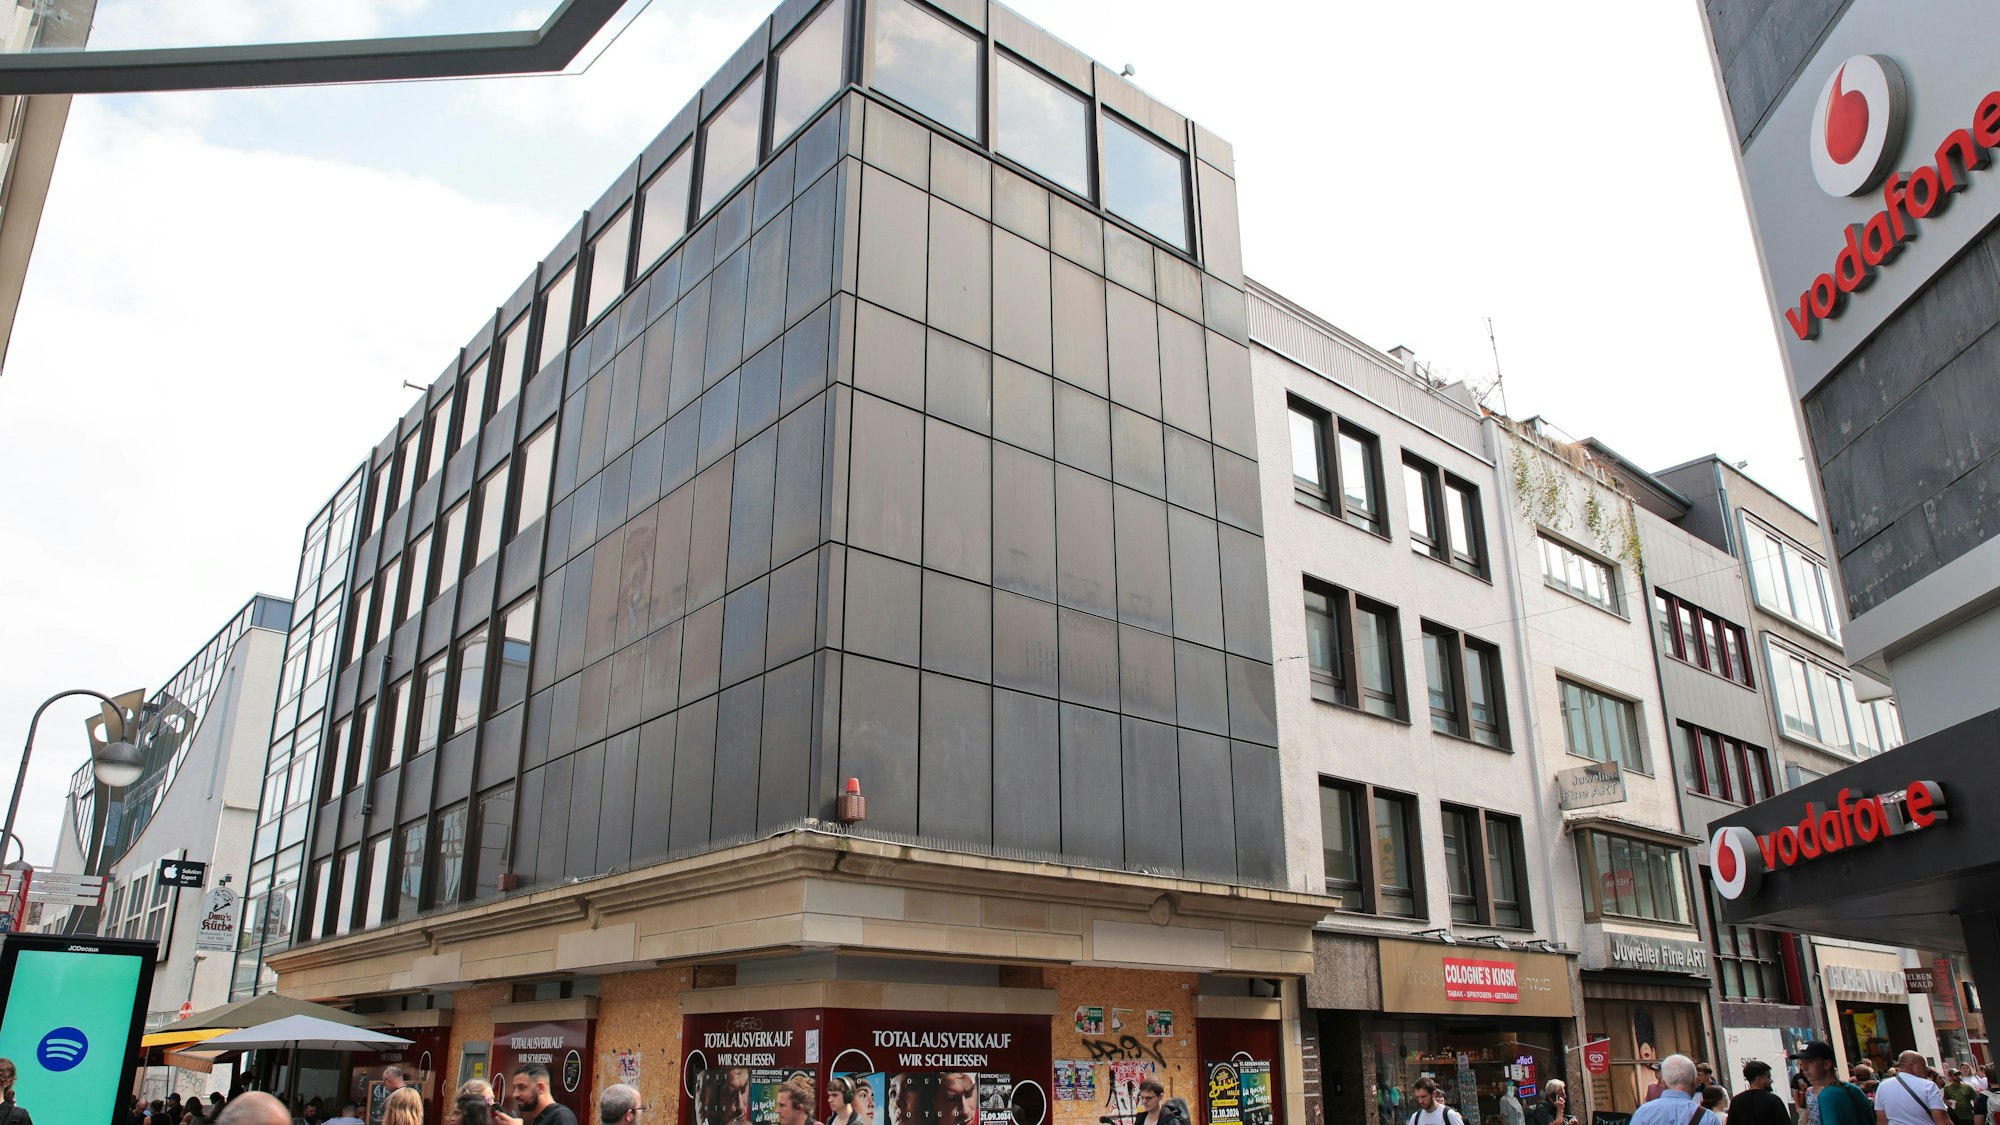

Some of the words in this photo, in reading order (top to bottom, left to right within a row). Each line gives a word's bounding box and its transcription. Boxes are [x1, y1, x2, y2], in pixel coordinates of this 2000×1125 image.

[1785, 90, 2000, 341] vodafone
[1571, 771, 1616, 787] Juwelier
[1562, 789, 1588, 801] Fine
[1591, 782, 1617, 797] ART
[40, 874, 71, 882] Shopping
[38, 884, 70, 892] Neumarkt
[68, 945, 99, 953] JCDecaux
[1613, 939, 1660, 964] Juwelier
[1660, 944, 1684, 966] Fine
[1686, 948, 1707, 968] ART
[1491, 967, 1517, 987] KIOSK
[1907, 972, 1932, 981] ELBEN
[1910, 980, 1933, 989] WALD
[1447, 990, 1464, 998] TABAK
[1495, 992, 1518, 1000] GETRÄNKE
[511, 1036, 564, 1049] TOTALAUSVERKAUF
[704, 1030, 794, 1048] TOTALAUSVERKAUF
[872, 1030, 1012, 1049] TOTALAUSVERKAUF
[518, 1053, 527, 1063] WIR
[527, 1053, 553, 1064] SCHLIESSEN
[718, 1053, 732, 1066] WIR
[733, 1053, 776, 1066] SCHLIESSEN
[898, 1053, 921, 1067] WIR
[925, 1053, 988, 1067] SCHLIESSEN
[1211, 1108, 1240, 1118] 12.10.2024
